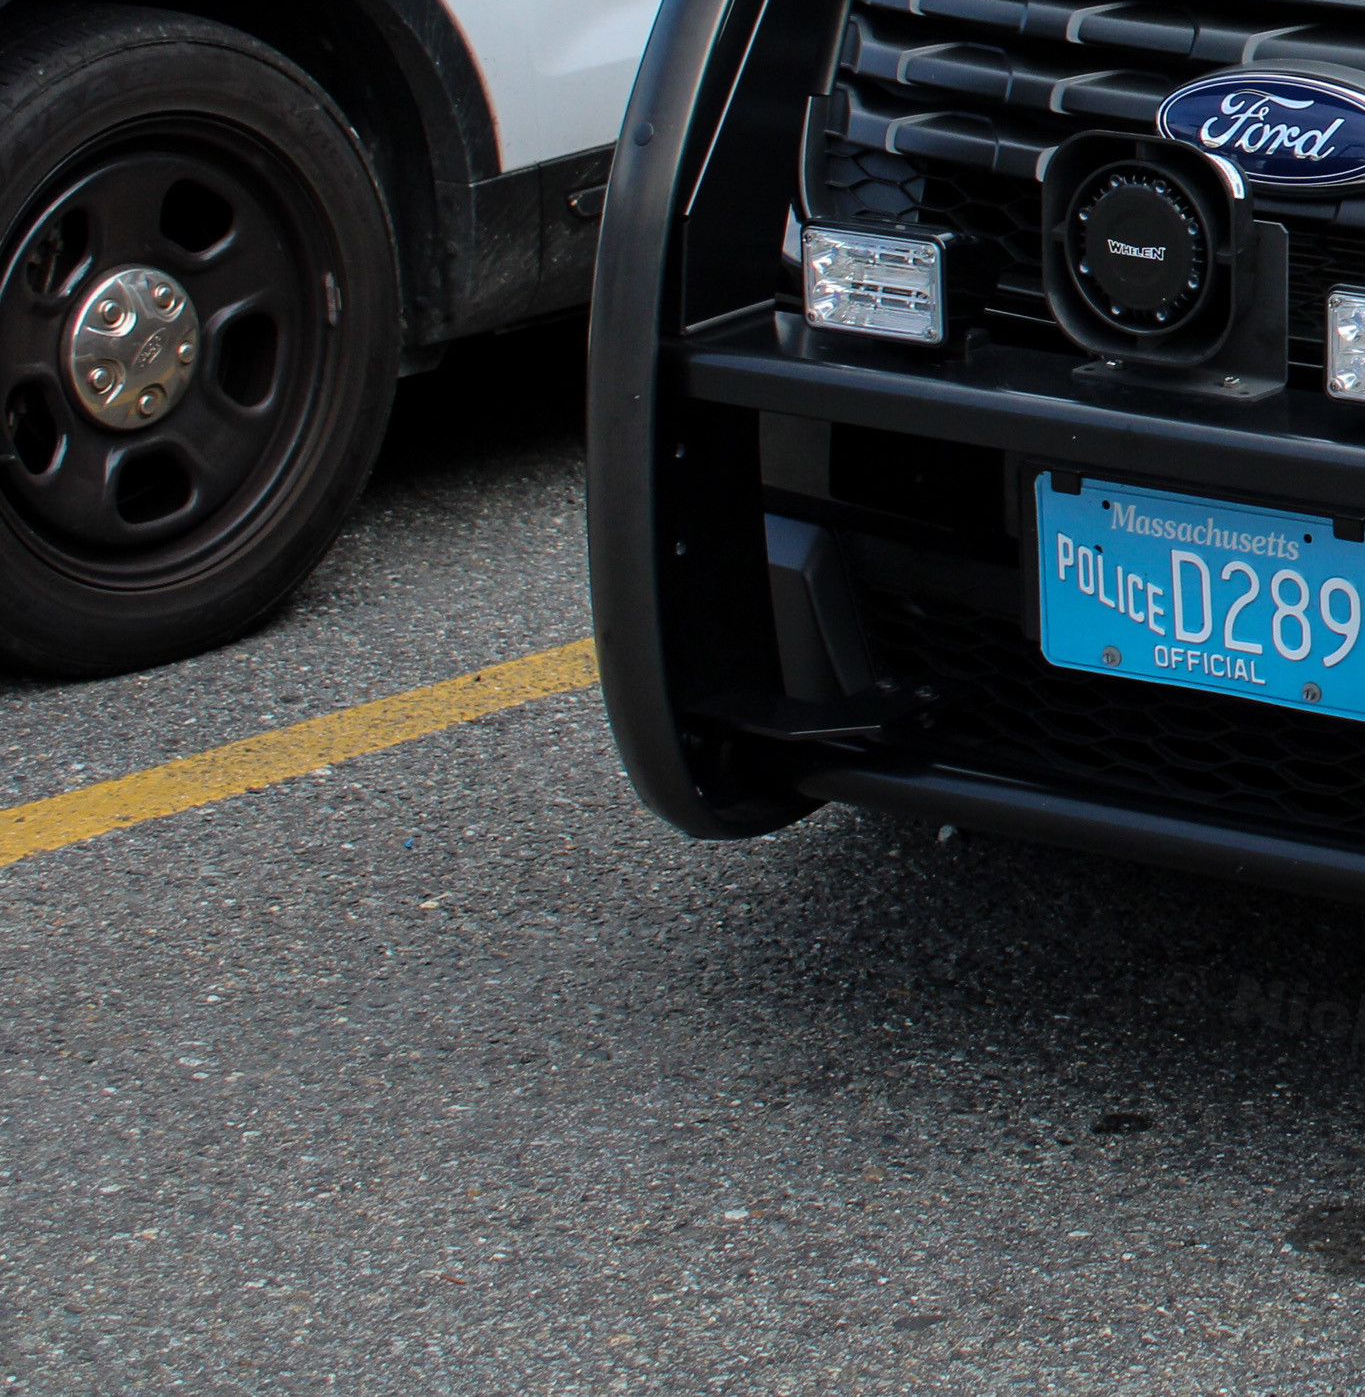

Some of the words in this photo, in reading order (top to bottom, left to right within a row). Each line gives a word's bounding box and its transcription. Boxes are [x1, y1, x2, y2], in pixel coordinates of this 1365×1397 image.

[1200, 89, 1345, 161] Ford
[1111, 502, 1299, 560] Massachusetts
[1057, 532, 1166, 636] POLICE
[1170, 549, 1361, 668] D289
[1154, 645, 1266, 685] OFFICIAL
